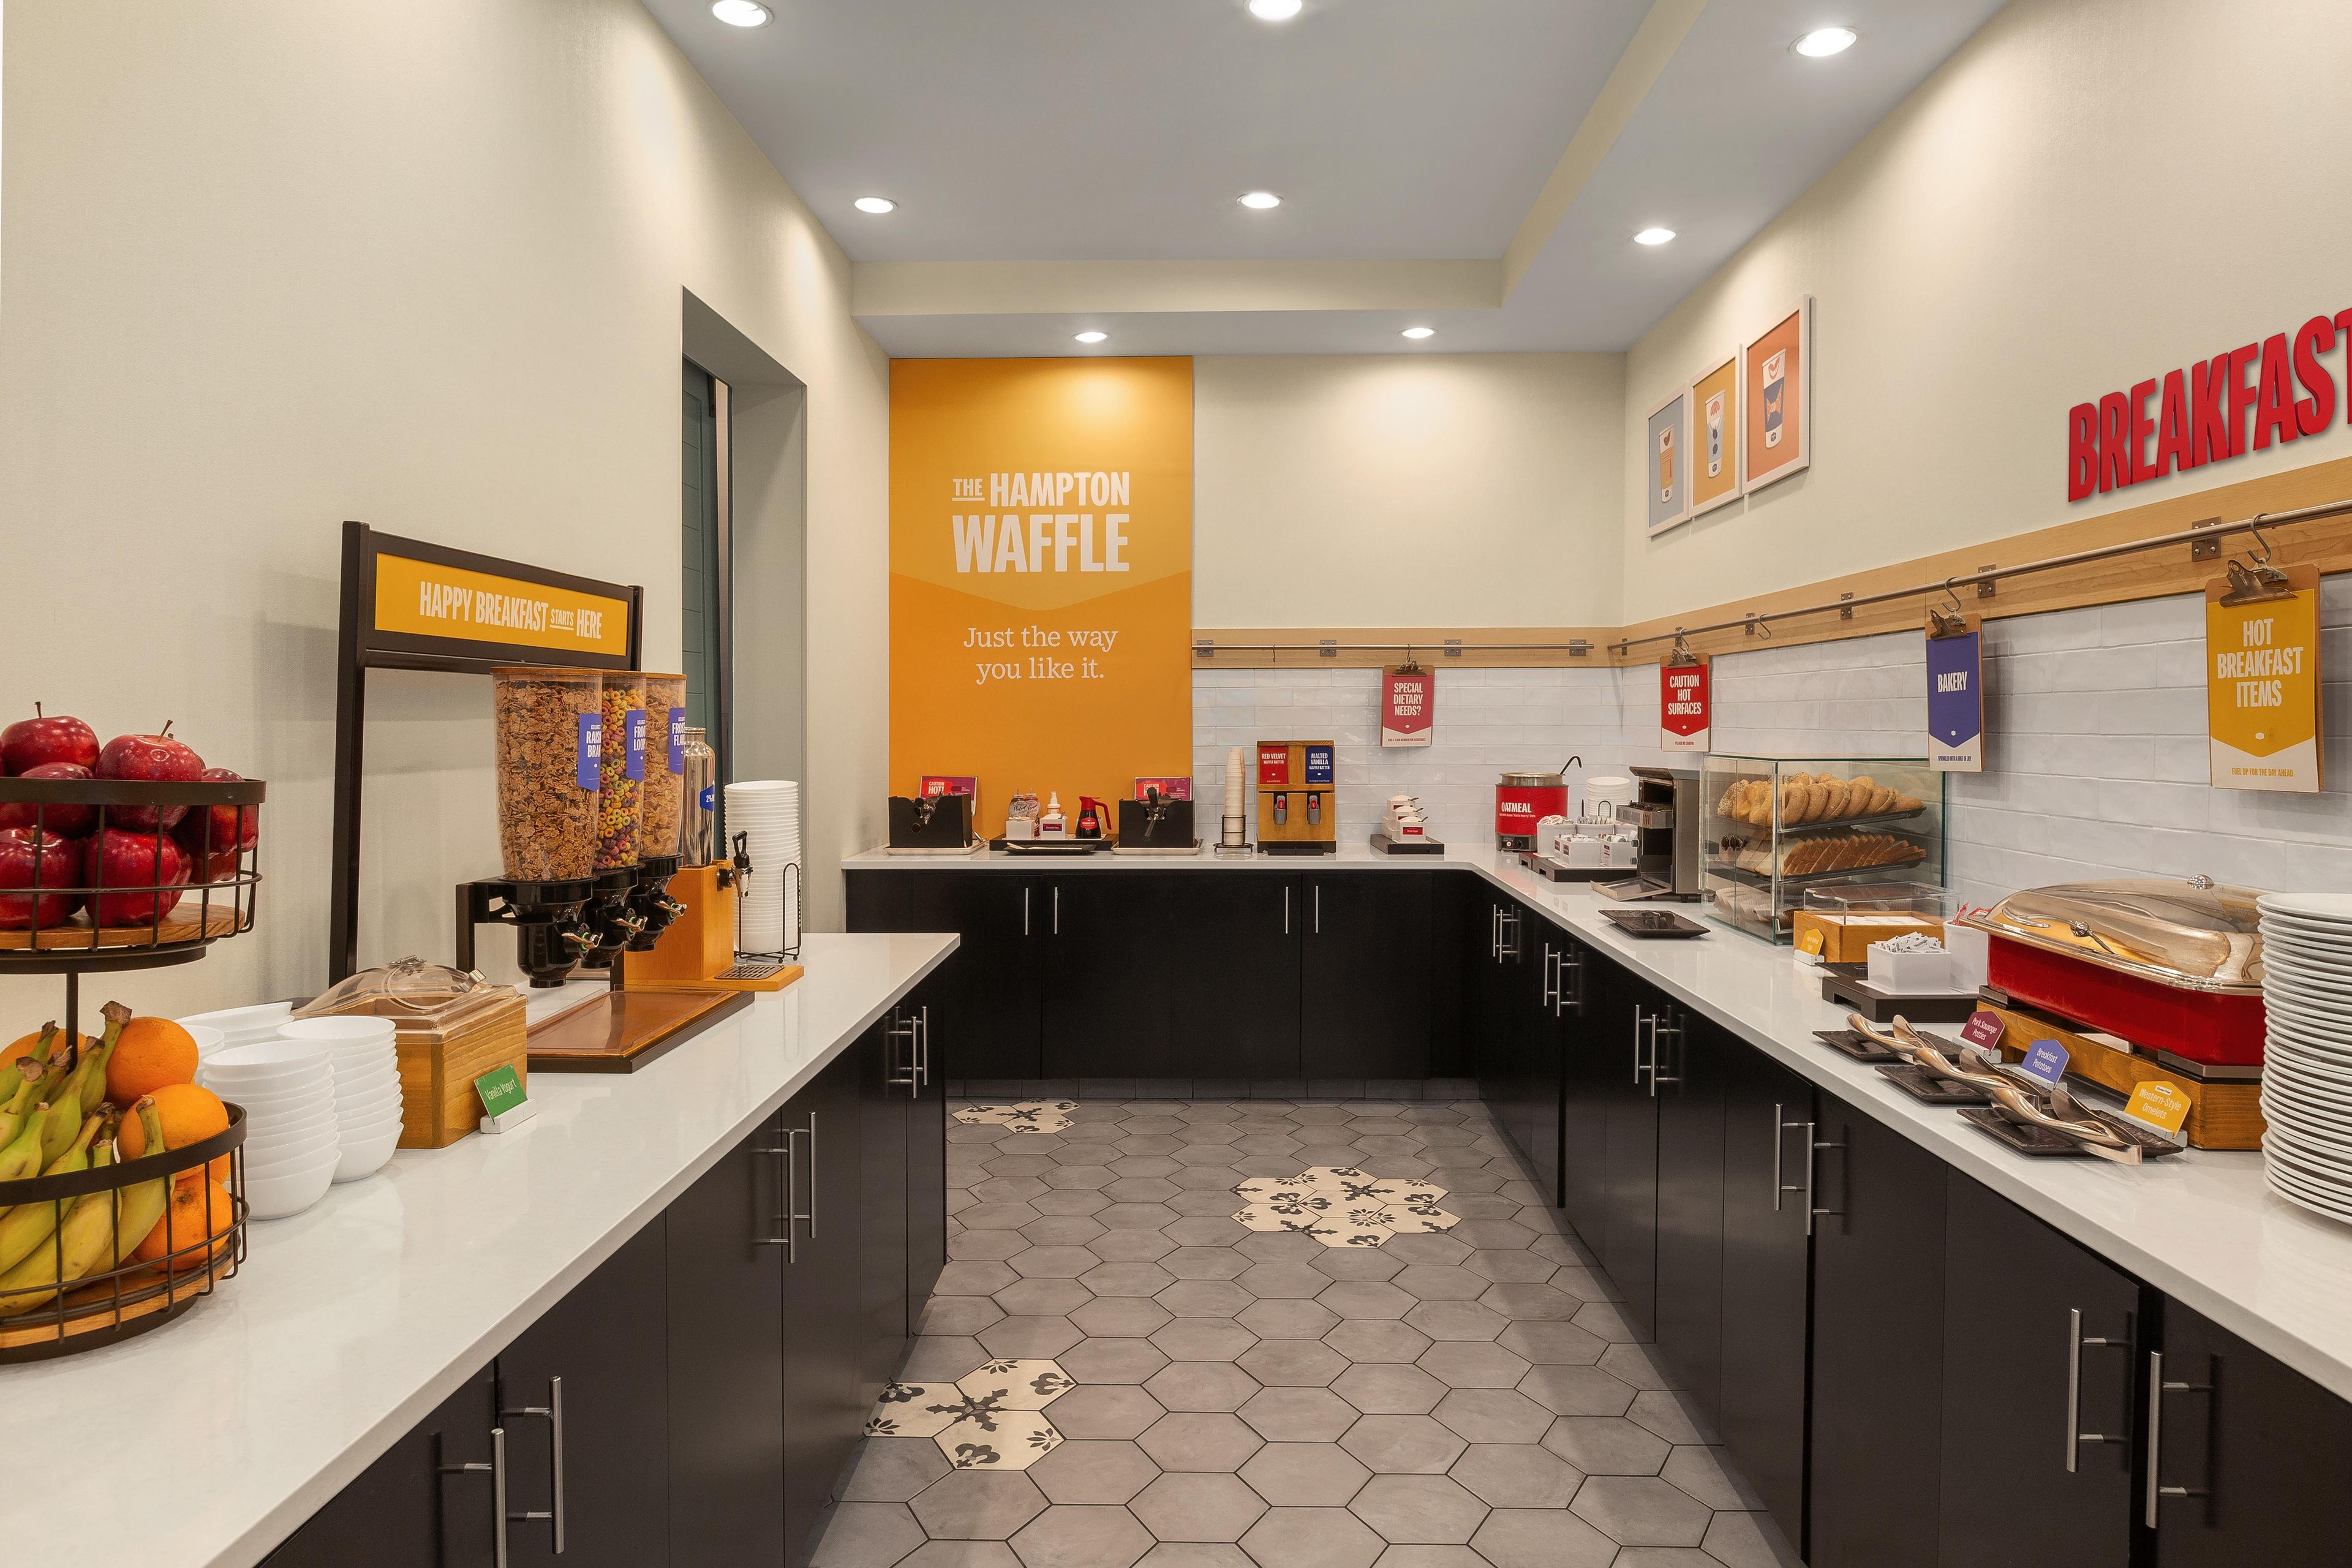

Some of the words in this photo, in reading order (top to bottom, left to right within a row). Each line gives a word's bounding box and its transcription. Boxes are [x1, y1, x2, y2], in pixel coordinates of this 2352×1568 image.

[953, 478, 982, 496] THE
[990, 472, 1129, 507] HAMPTON
[952, 513, 1129, 573] WAFFLE
[420, 581, 472, 621] HAPPY
[475, 590, 549, 631] BREAKFAST
[551, 609, 574, 627] STARTS
[576, 608, 602, 639] HERE
[963, 627, 1014, 647] Just
[1021, 625, 1061, 647] the
[1067, 630, 1118, 652] way
[2243, 618, 2274, 647] HOT
[976, 663, 1022, 685] you
[1028, 657, 1074, 679] like
[1081, 657, 1104, 679] it.
[2217, 647, 2304, 679] BREAKFAST
[1393, 682, 1423, 693] SPECIAL
[1669, 674, 1700, 688] CAUTION
[1937, 671, 1968, 693] BAKERY
[1393, 694, 1423, 704] DIETARY
[1677, 688, 1691, 701] HOT
[2236, 679, 2282, 708] ITEMS
[1394, 706, 1421, 716] NEEDS?
[1668, 702, 1702, 715] SURFACES
[671, 723, 685, 734] FROS
[586, 731, 601, 744] RAISI
[633, 738, 646, 751] LOOP
[1501, 802, 1531, 813] OATMEAL
[1972, 1017, 1981, 1027] Pork
[1980, 1020, 1997, 1035] Sausage
[1972, 1028, 1986, 1040] Patties
[2037, 1047, 2058, 1063] Breakfast
[2032, 1058, 2052, 1073] Potatoes
[484, 1086, 503, 1101] Vanilla
[499, 1078, 517, 1094] Yogurt
[2139, 1088, 2182, 1111] Western-Style
[2142, 1102, 2167, 1119] Omelets
